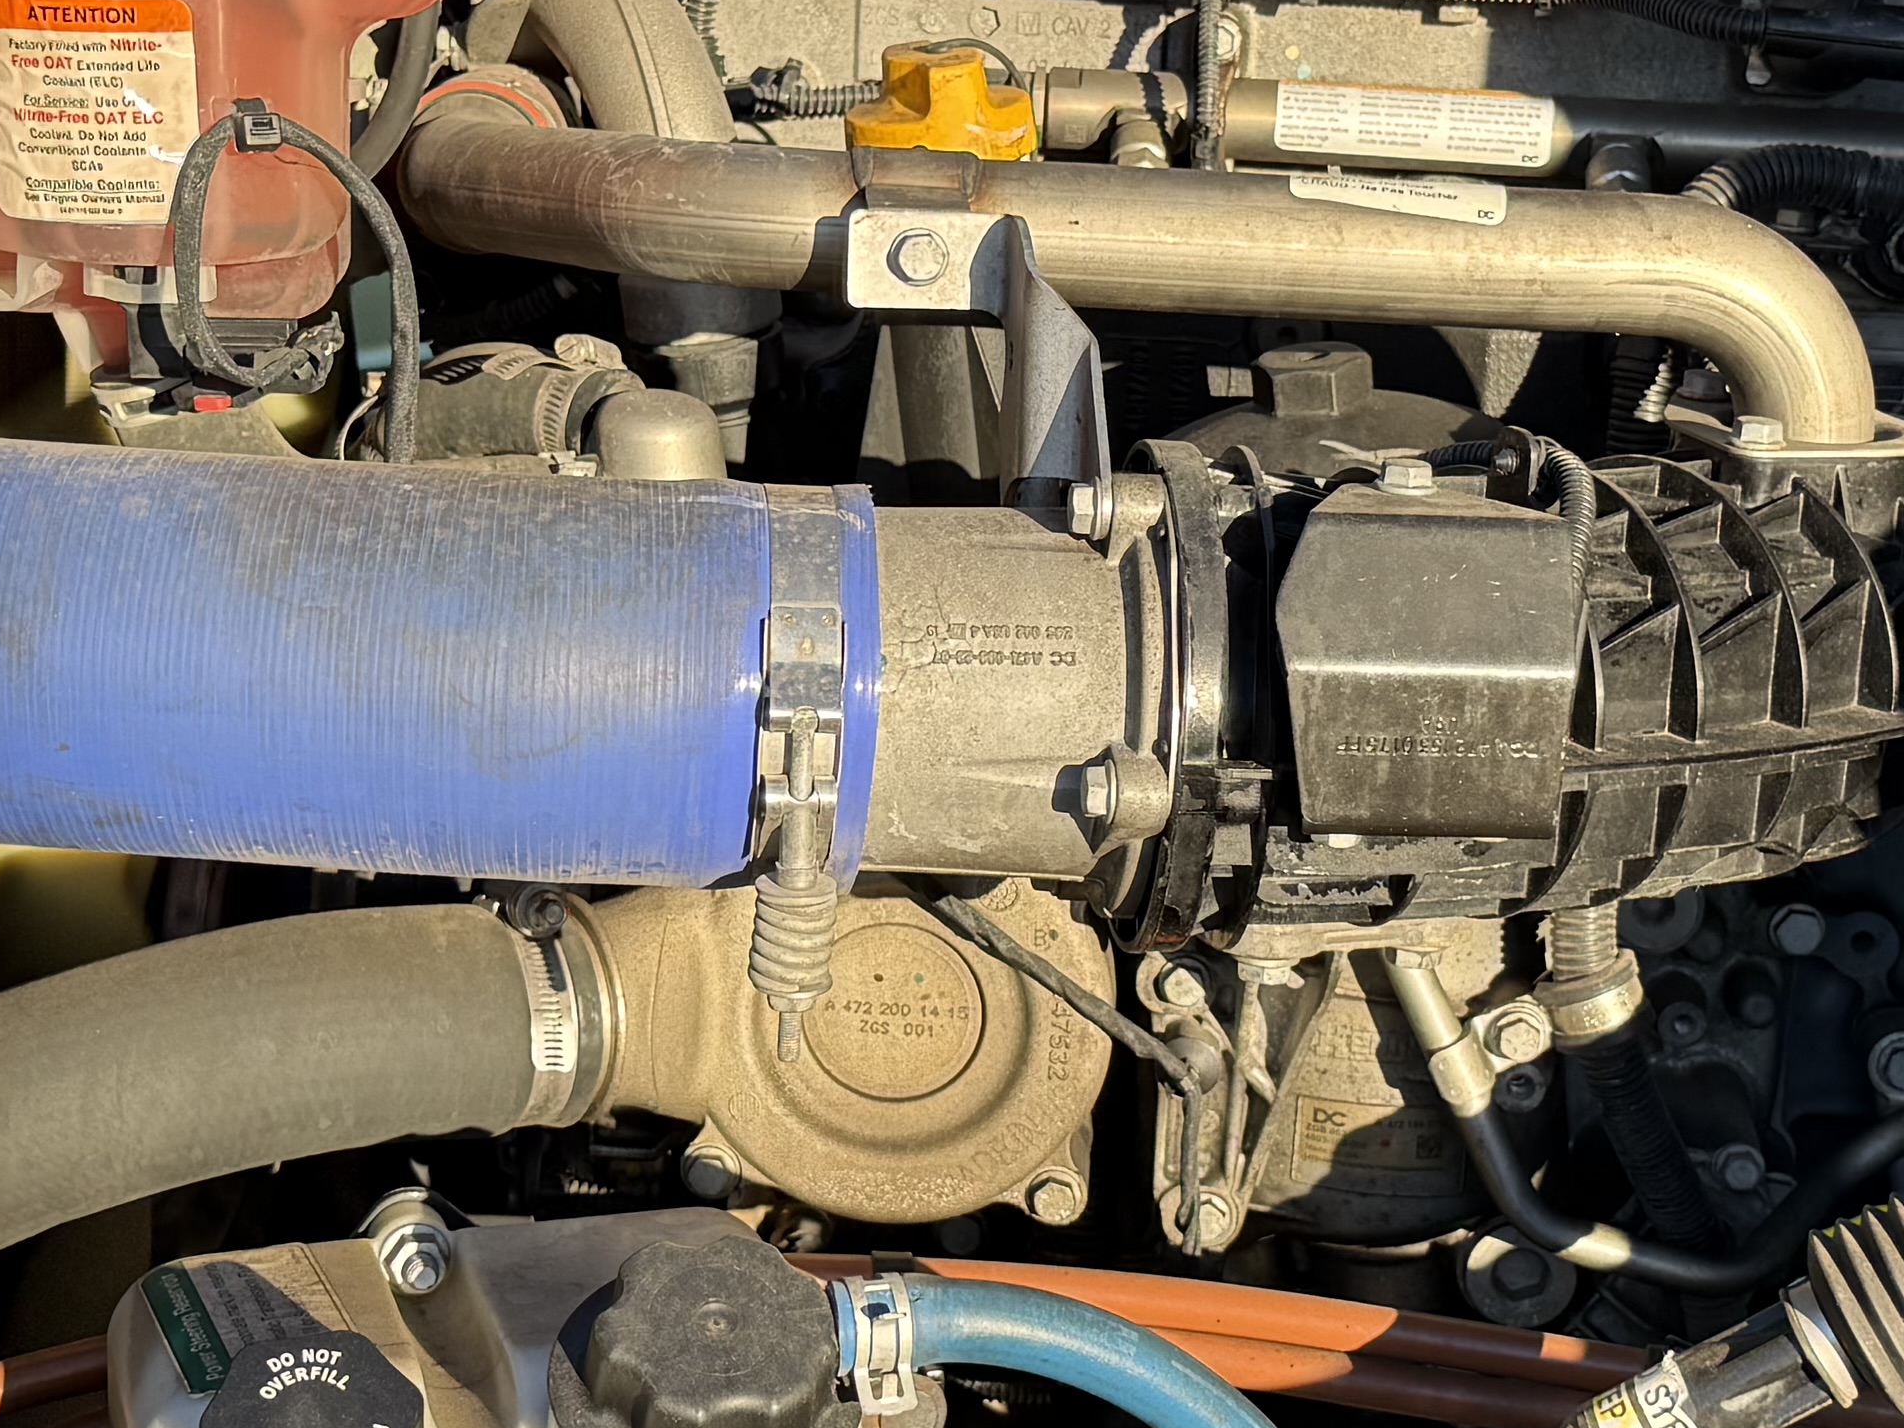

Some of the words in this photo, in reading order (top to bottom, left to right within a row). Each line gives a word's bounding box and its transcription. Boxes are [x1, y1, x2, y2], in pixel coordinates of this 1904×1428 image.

[27, 5, 136, 24] ATTENTION
[1051, 16, 1091, 37] CAV
[1096, 19, 1112, 39] 2
[8, 38, 46, 53] Factory
[110, 38, 163, 52] Nitrite-
[11, 54, 40, 69] Free
[43, 55, 74, 71] OAT
[76, 60, 134, 72] Extended
[137, 61, 161, 72] Life
[42, 74, 86, 87] Coolant
[89, 75, 124, 89] (ELC)
[23, 94, 45, 106] For
[95, 96, 119, 108] Use
[94, 111, 127, 125] OAT
[132, 111, 164, 125] ELC
[78, 129, 95, 141] Do
[98, 129, 120, 141] Not
[122, 129, 146, 142] Add
[18, 141, 90, 156] Conventional
[93, 145, 147, 157] Coolants
[1521, 154, 1539, 164] DC
[25, 176, 94, 192] Compatible
[97, 179, 160, 191] Coolants:
[1477, 209, 1496, 221] DC
[824, 1000, 836, 1012] A
[841, 1001, 874, 1015] 472
[879, 1002, 912, 1017] 200
[920, 1004, 941, 1018] 14
[947, 1006, 970, 1021] 15
[859, 1020, 891, 1035] ZGS
[903, 1022, 935, 1037] 001
[1047, 1002, 1074, 1082] 47532
[1312, 1106, 1348, 1127] DC
[156, 1270, 194, 1318] Reservoir
[175, 1308, 216, 1356] Steering
[195, 1347, 227, 1384] Power
[265, 1348, 296, 1373] DO
[301, 1348, 343, 1367] NOT
[258, 1366, 351, 1401] OVERFILL
